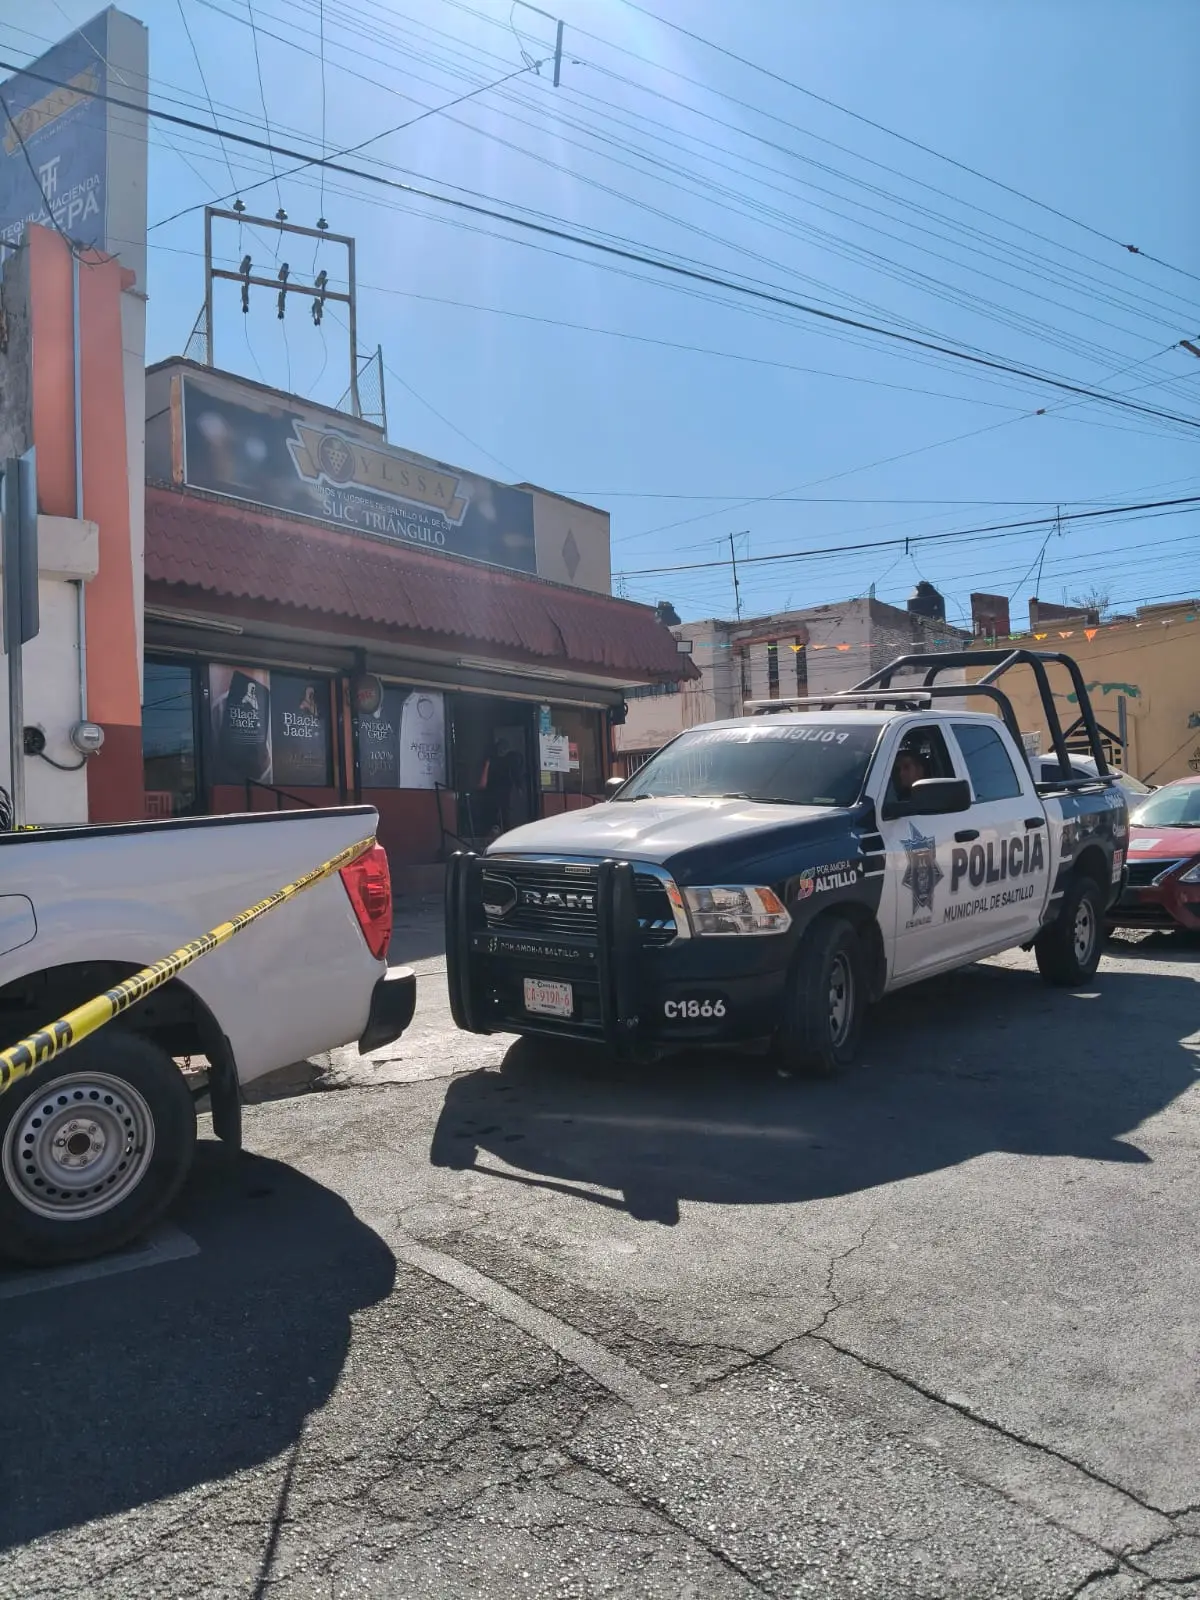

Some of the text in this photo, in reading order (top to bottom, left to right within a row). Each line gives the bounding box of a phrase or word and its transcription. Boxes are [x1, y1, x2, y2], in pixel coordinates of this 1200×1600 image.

[49, 174, 100, 211] HACIENDA
[322, 500, 359, 524] SUC.
[230, 707, 260, 720] Black
[283, 712, 320, 727] Black
[231, 718, 255, 728] Jack
[283, 725, 313, 738] Jack
[522, 890, 595, 910] RAM
[943, 898, 988, 924] MUNICIPAL
[989, 895, 1000, 912] DE
[1002, 885, 1034, 908] SALTILLO
[664, 1000, 726, 1018] C1866
